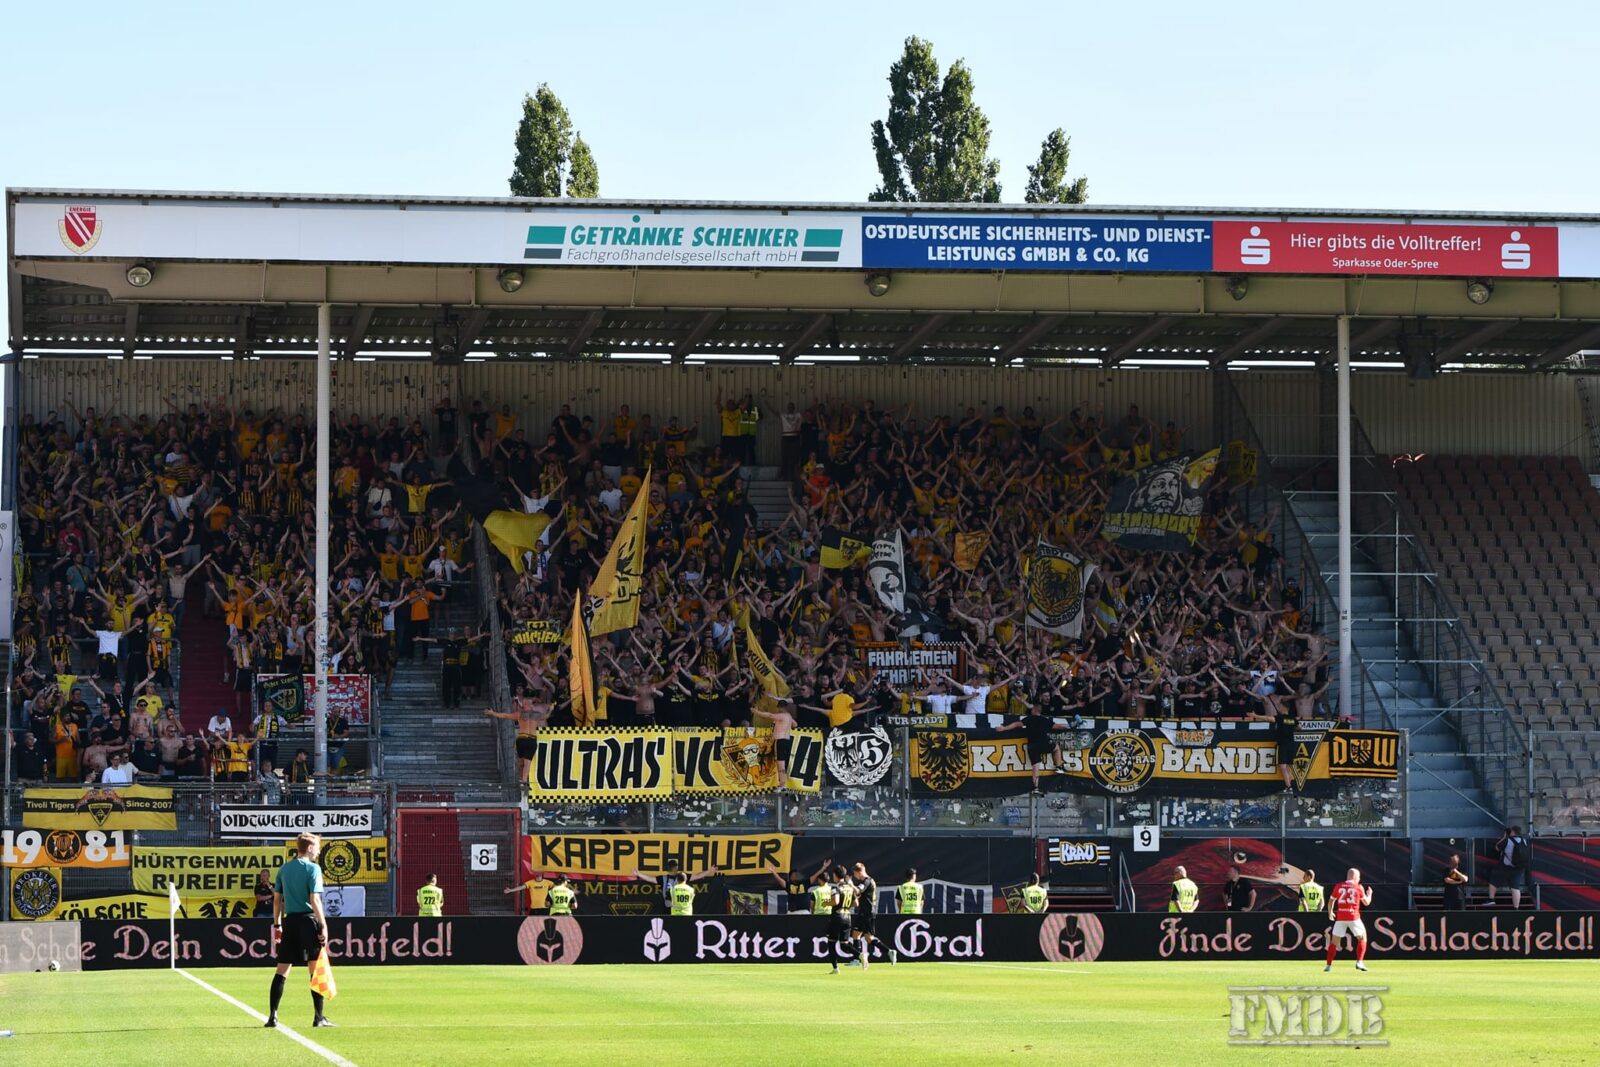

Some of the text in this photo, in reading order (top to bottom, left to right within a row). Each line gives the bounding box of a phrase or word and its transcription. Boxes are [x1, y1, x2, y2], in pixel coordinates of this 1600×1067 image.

[692, 228, 799, 247] SCHENKER
[865, 224, 1211, 243] OSTDEUTSCHE SICHERHEITS- UND DIENST-
[1290, 233, 1482, 251] Hier gibts die Volltreffer!
[567, 248, 798, 263] Fachgroßhandelsgesellschaft mbH
[927, 246, 1149, 263] LEISTUNGS GMBH & CO. KG
[1332, 257, 1439, 270] Sparkasse Oder-Spree
[888, 714, 945, 725] FÜR STADT
[1296, 742, 1309, 757] A
[537, 736, 666, 789] ULTRAS
[1161, 744, 1277, 774] BANDE
[26, 800, 173, 810] Tivoli Tigers Since 2007
[322, 813, 369, 828] JUNGS
[1, 830, 129, 864] 19 81
[1140, 830, 1152, 847] 9
[134, 853, 284, 869] HÜRTGENWALD
[363, 847, 387, 871] 15
[479, 849, 490, 865] 8
[540, 833, 782, 872] KAPPEHÄUER
[152, 873, 262, 890] RUREIFE
[423, 896, 436, 905] 272
[554, 895, 568, 904] 284
[676, 894, 690, 903] 109
[1338, 887, 1356, 904] 23
[113, 923, 203, 962] Dein
[695, 918, 800, 960] Ritter
[893, 917, 985, 958] Gral
[1158, 916, 1253, 958] Finde
[1369, 915, 1594, 956] Schlachtfeld!
